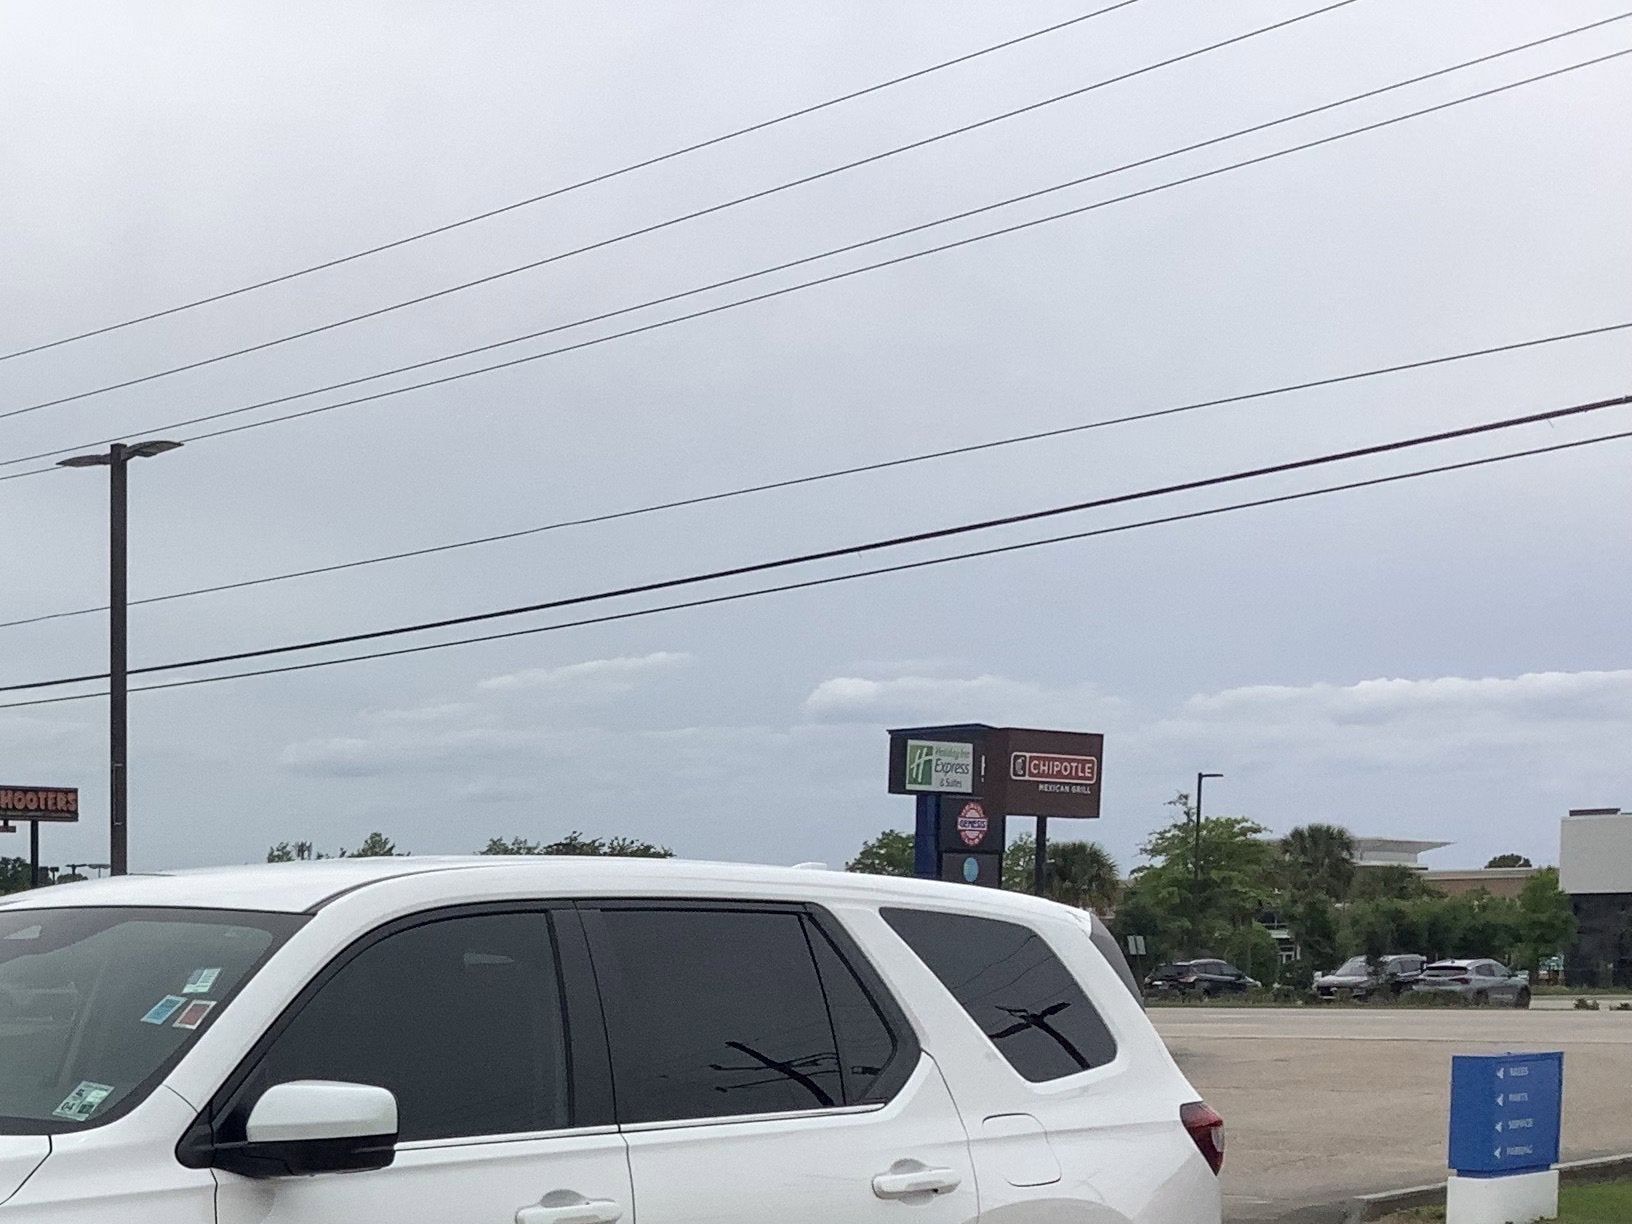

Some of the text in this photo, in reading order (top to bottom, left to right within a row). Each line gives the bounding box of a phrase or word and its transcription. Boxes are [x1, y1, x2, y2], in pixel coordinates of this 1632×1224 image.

[934, 758, 970, 777] Express
[1030, 759, 1093, 777] CHIPOTLE
[1038, 783, 1091, 794] MEXICAN GRILL
[0, 789, 77, 811] HOOTERS
